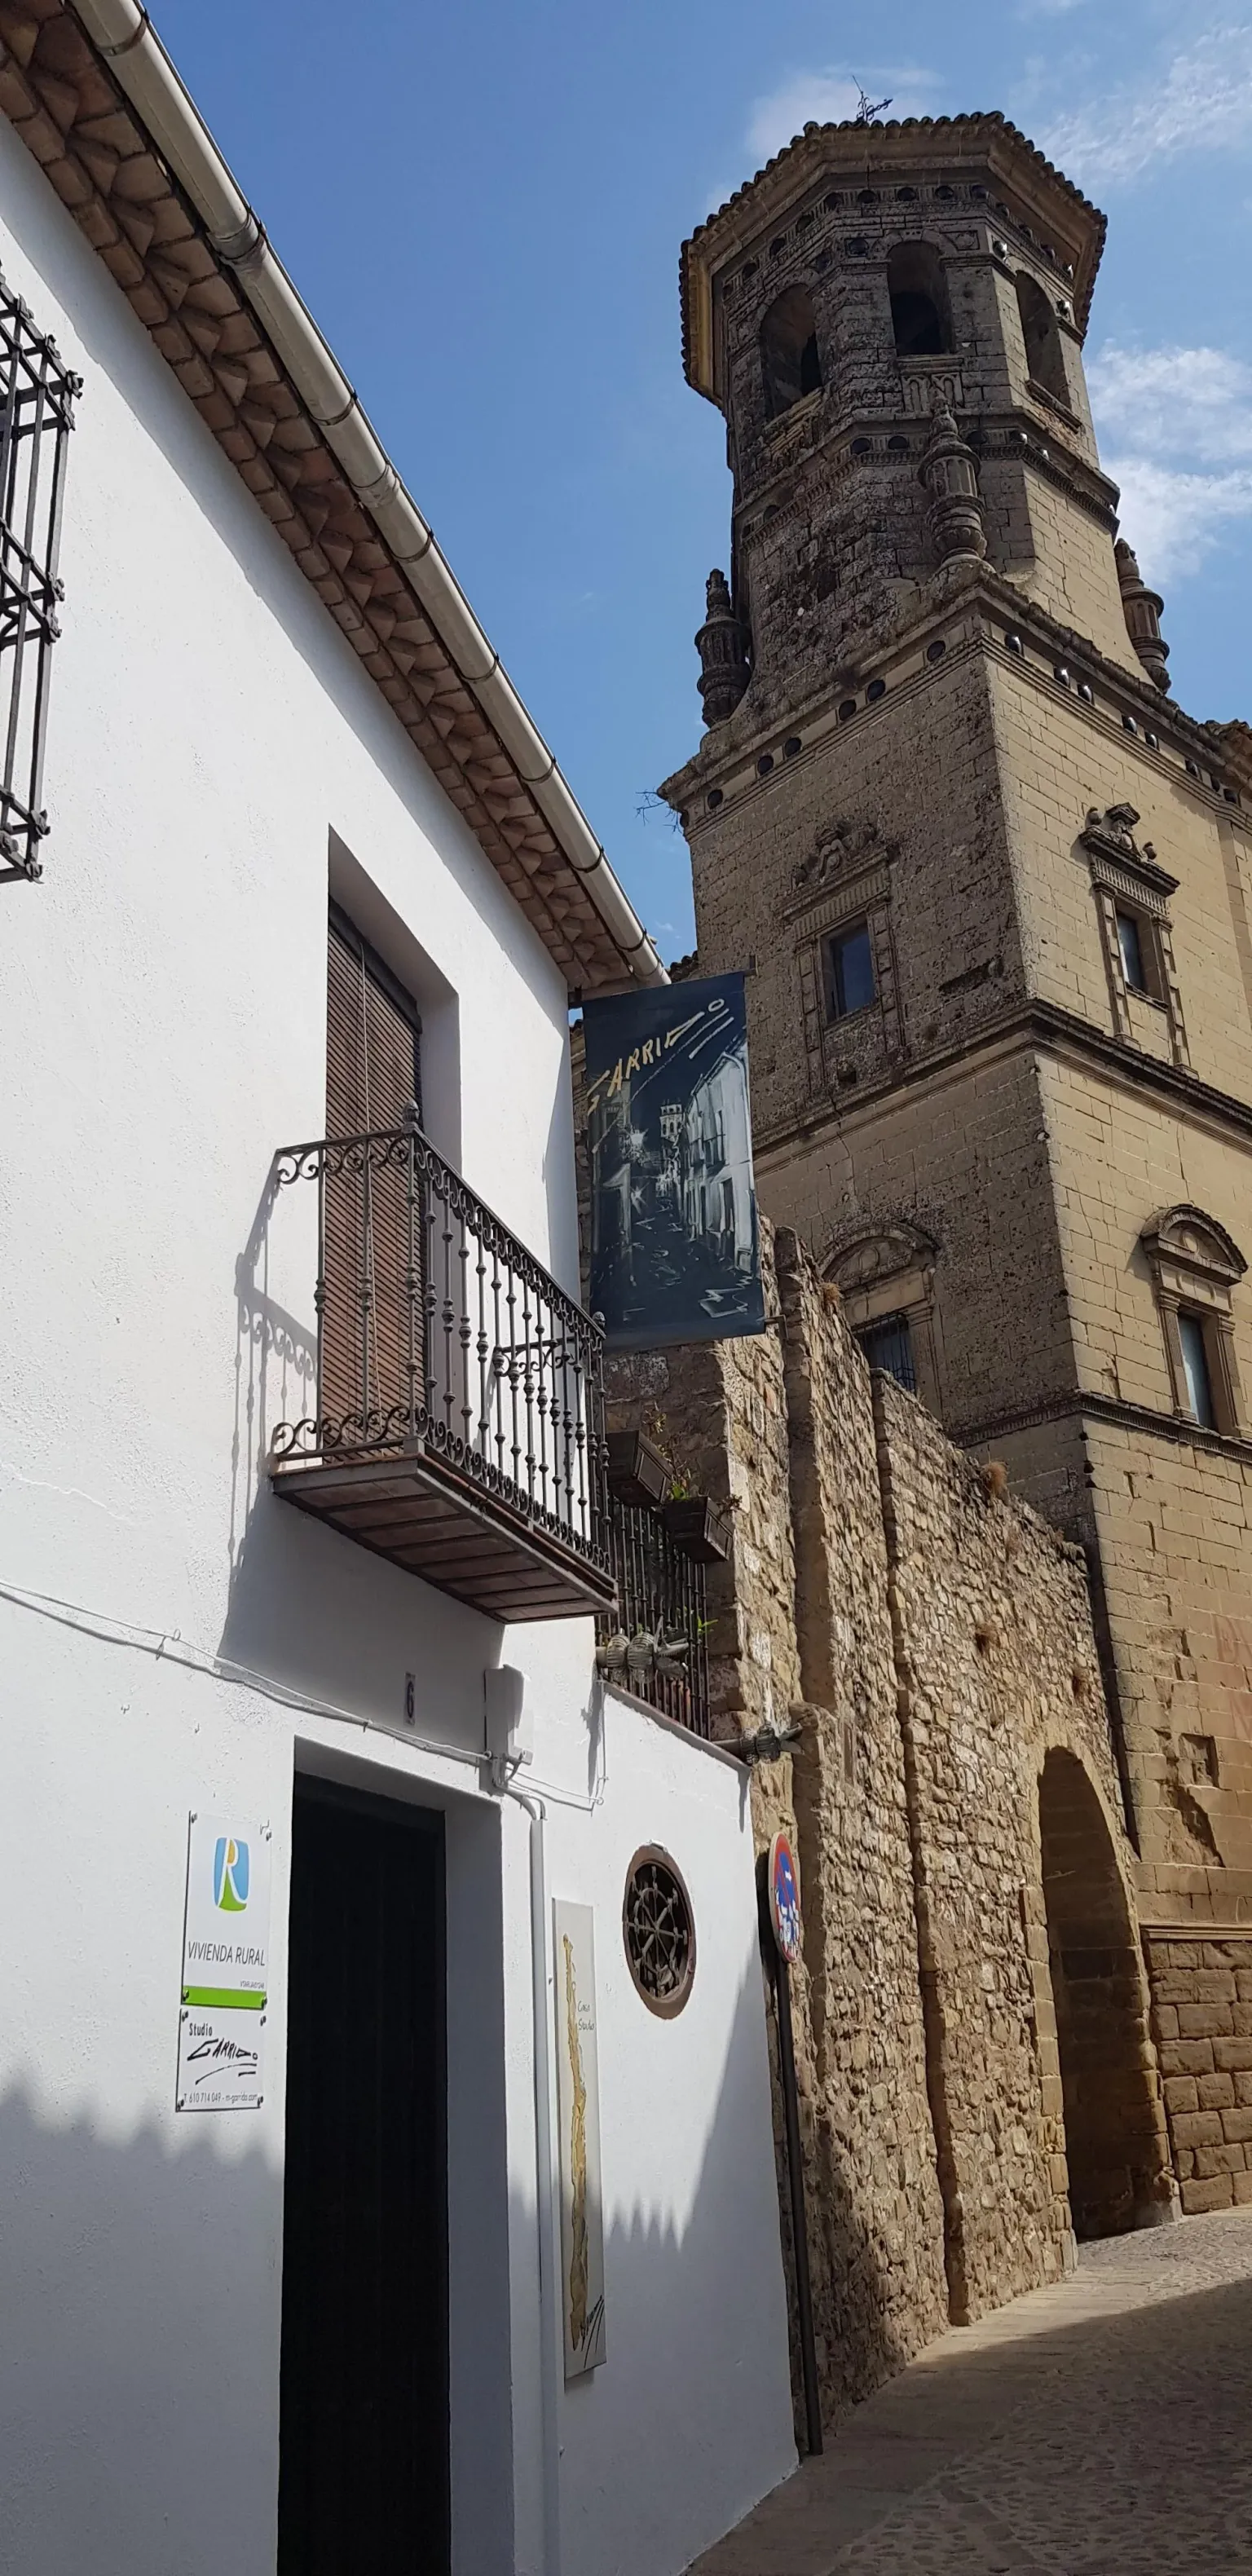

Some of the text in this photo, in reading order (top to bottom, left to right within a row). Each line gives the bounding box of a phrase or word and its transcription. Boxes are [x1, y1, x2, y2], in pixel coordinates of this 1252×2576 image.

[407, 1681, 415, 1719] 6
[188, 1941, 266, 1966] VIVIENDA RURAL
[189, 2022, 213, 2036] Studio
[189, 2092, 200, 2103] 610
[201, 2092, 210, 2103] 714
